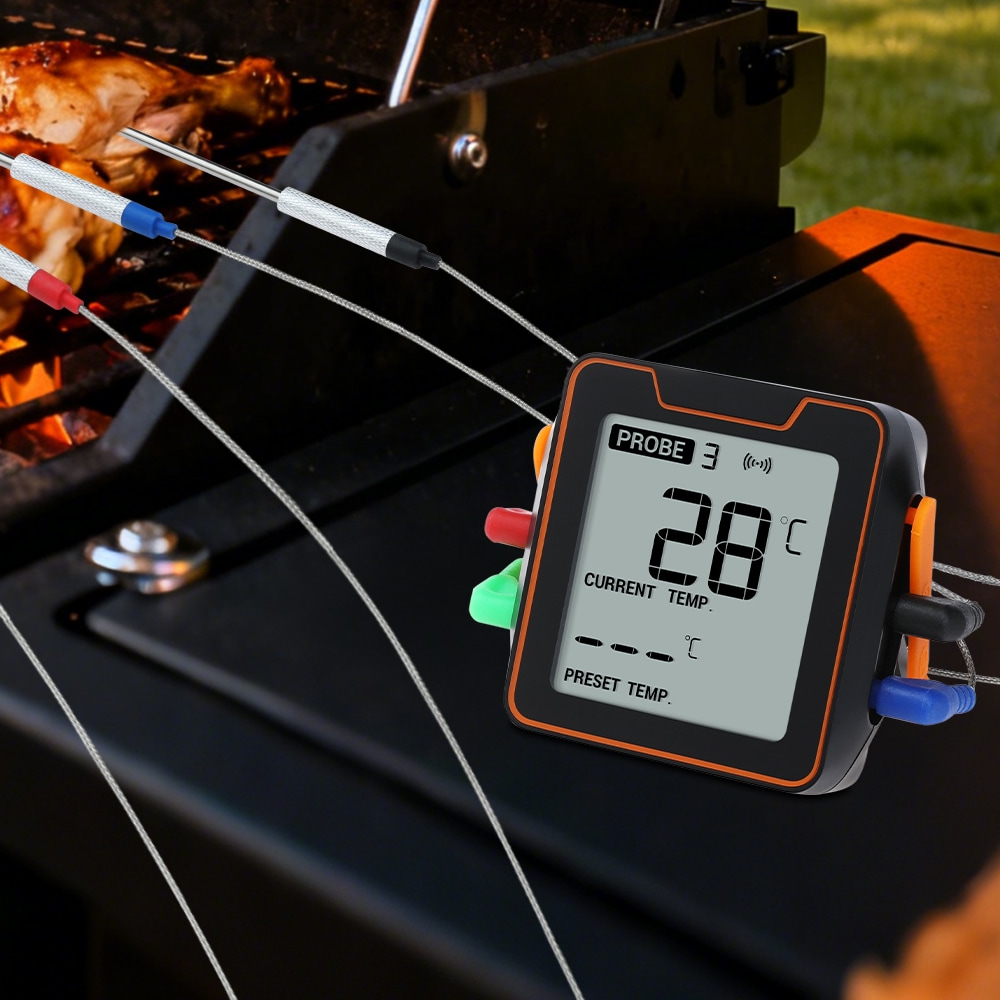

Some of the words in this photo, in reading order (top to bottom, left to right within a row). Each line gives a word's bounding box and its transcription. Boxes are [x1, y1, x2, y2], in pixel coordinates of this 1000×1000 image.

[615, 429, 687, 460] PROBE
[700, 441, 720, 471] 3
[648, 487, 773, 601] 28
[583, 571, 657, 600] CURRENT
[668, 588, 714, 612] TEMP.
[563, 667, 621, 694] PRESET
[627, 680, 673, 705] TEMP.
